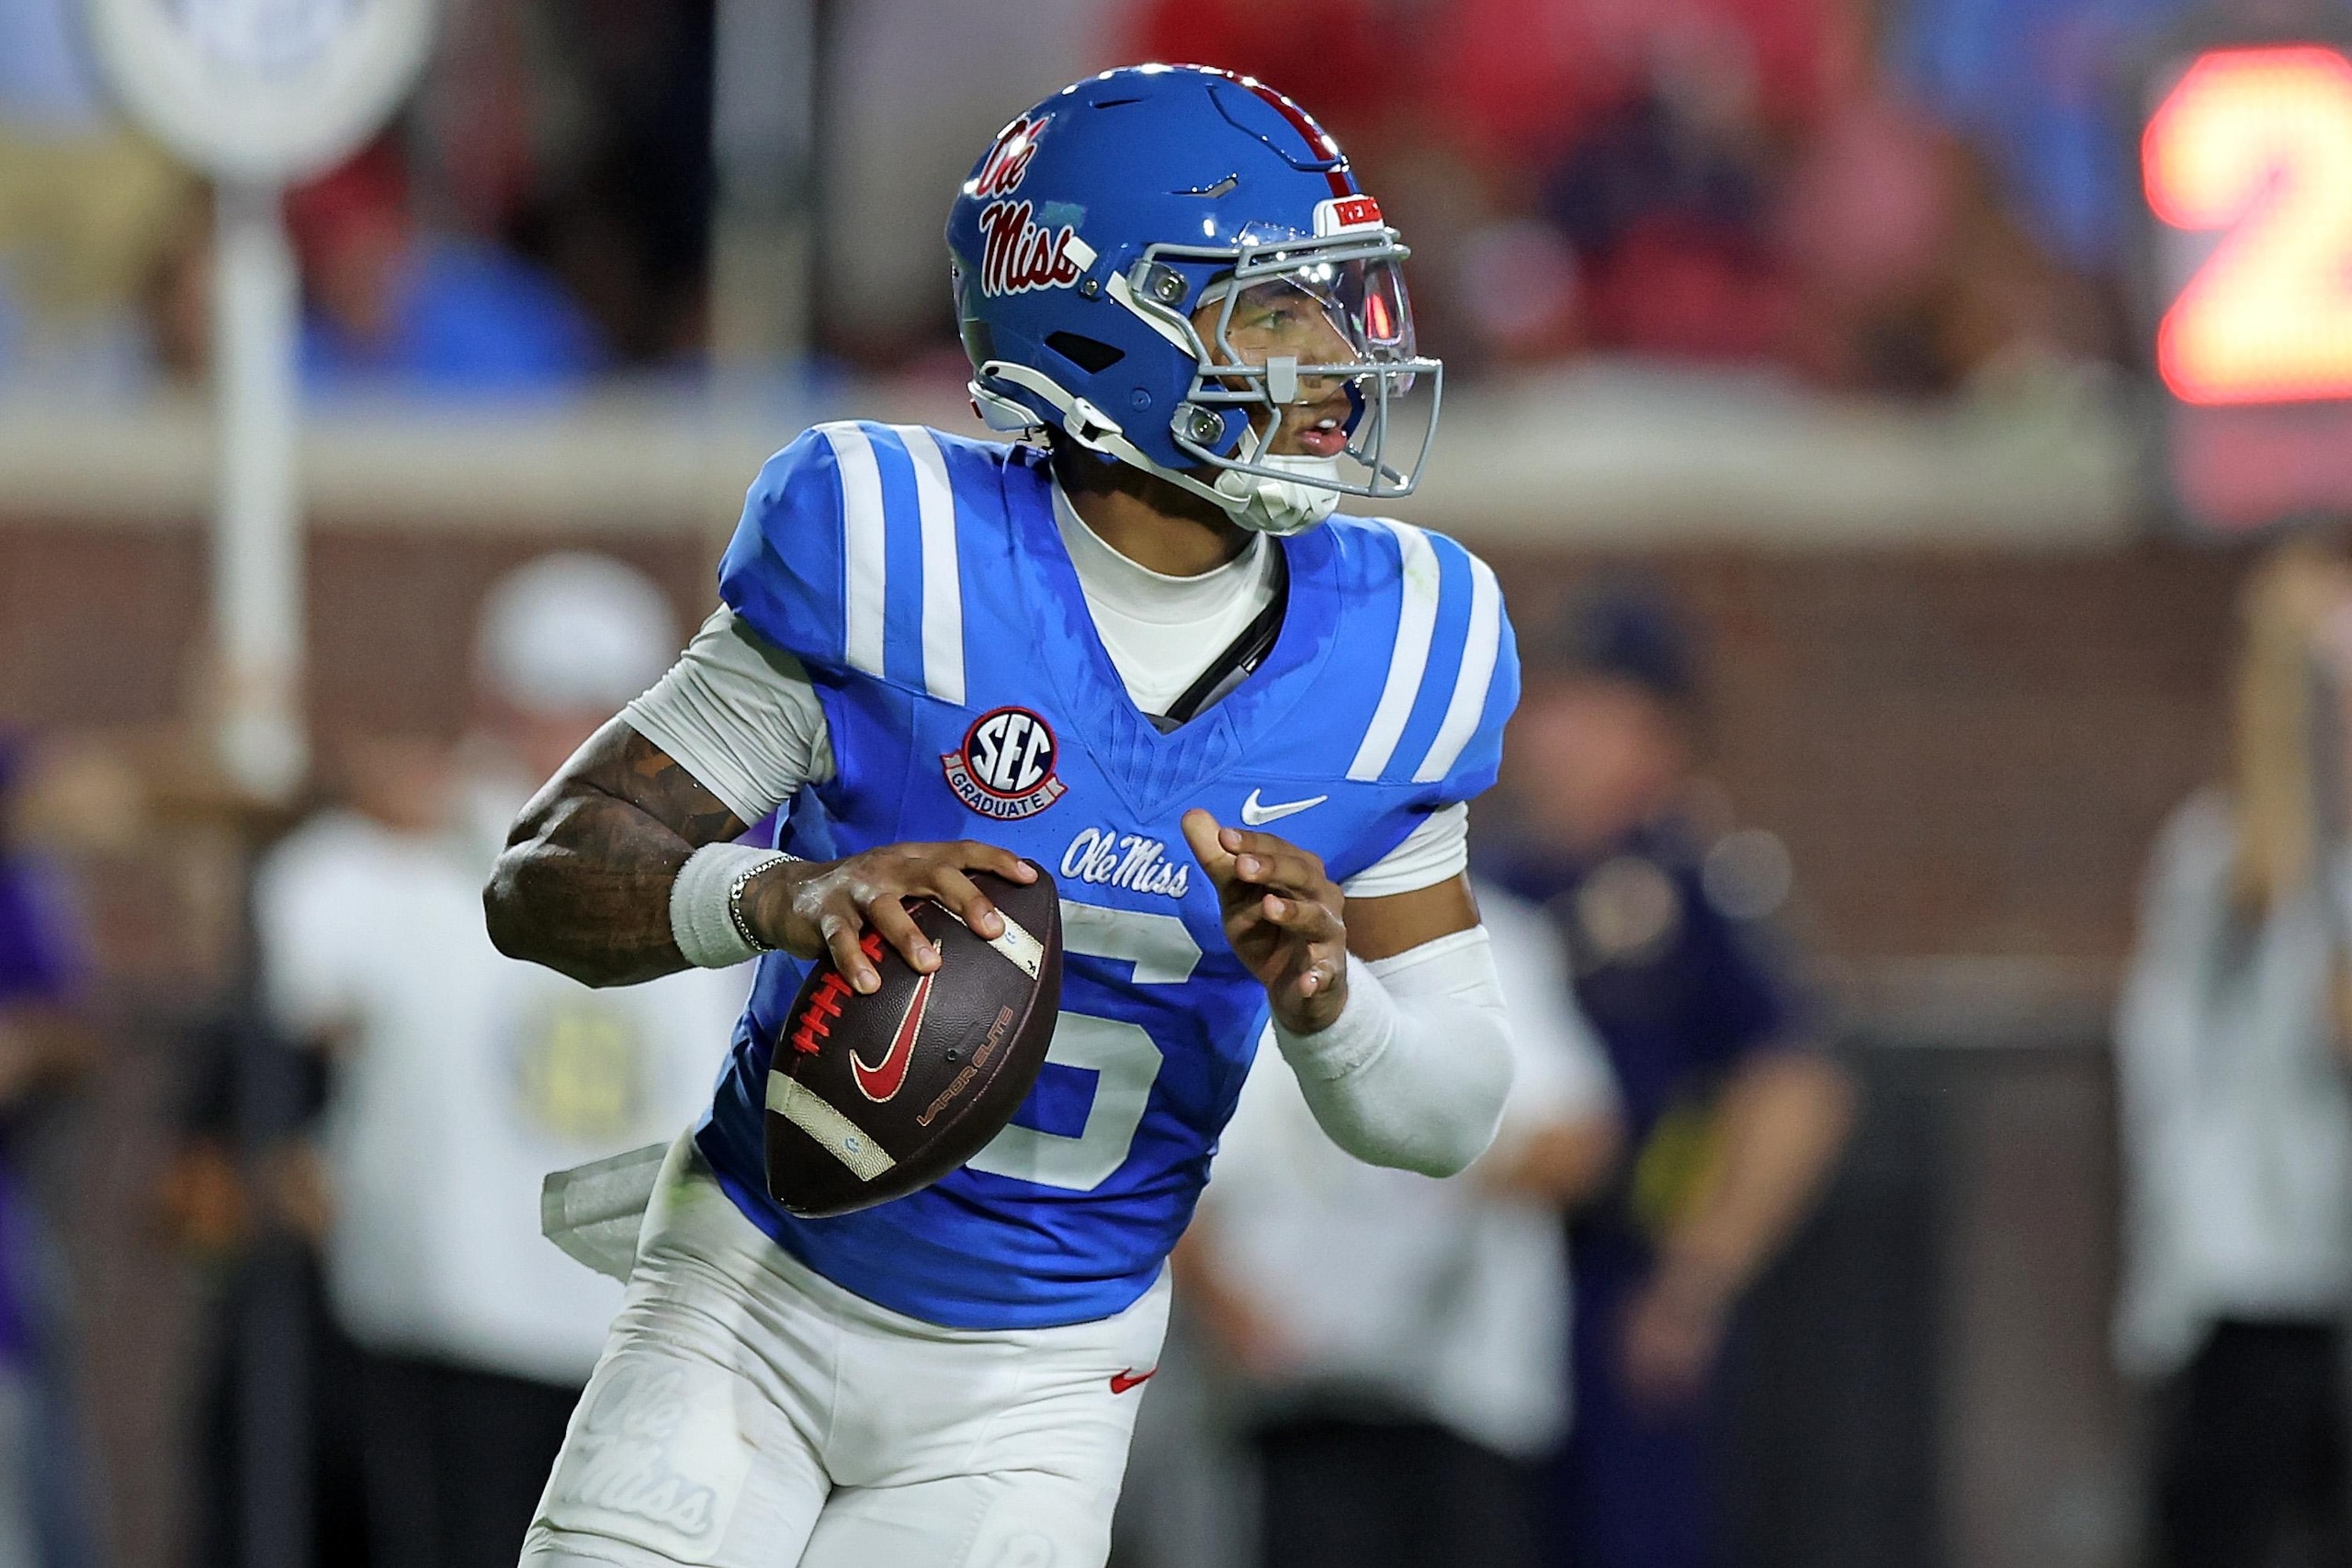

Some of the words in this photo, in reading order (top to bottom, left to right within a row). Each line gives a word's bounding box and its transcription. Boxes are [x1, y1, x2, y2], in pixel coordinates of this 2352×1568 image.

[974, 114, 1050, 200] Ole
[978, 199, 1081, 298] Miss
[2140, 42, 2352, 407] 2
[951, 772, 1045, 818] GRADUATE
[971, 713, 1051, 791] SEC
[1060, 826, 1118, 884] Ole
[1111, 833, 1189, 898] Miss
[916, 1066, 978, 1127] VAPOR
[971, 1005, 1013, 1067] ELITE
